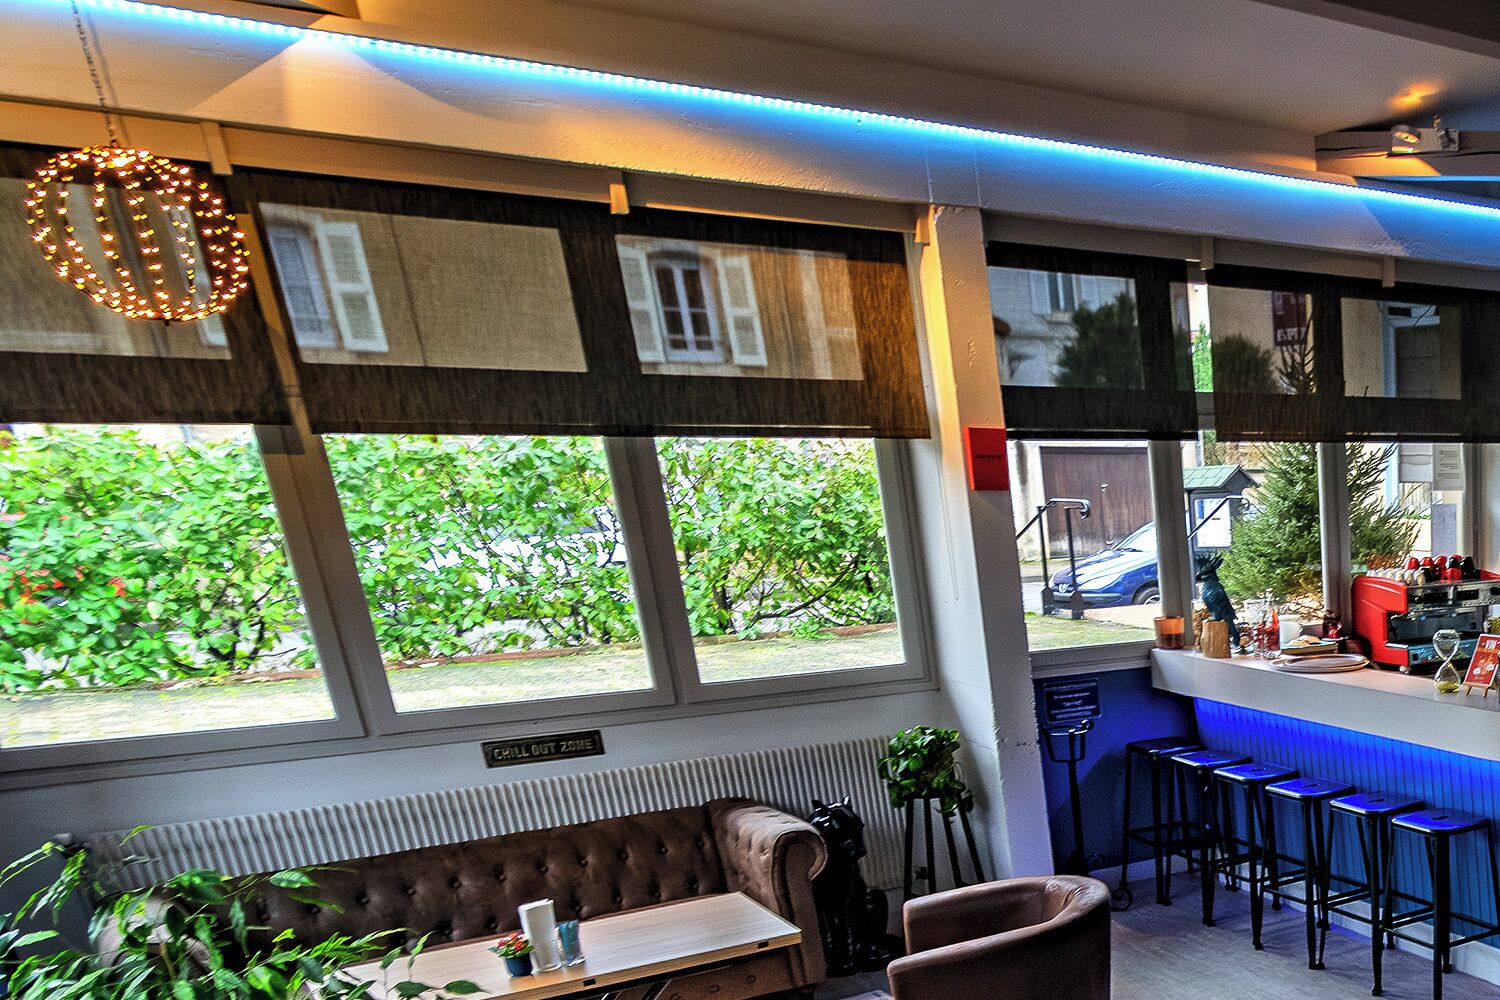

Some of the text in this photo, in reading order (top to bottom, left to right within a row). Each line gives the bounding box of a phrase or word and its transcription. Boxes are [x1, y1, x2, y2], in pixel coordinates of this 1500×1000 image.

[494, 737, 593, 760] CHILL OUT ZONE
